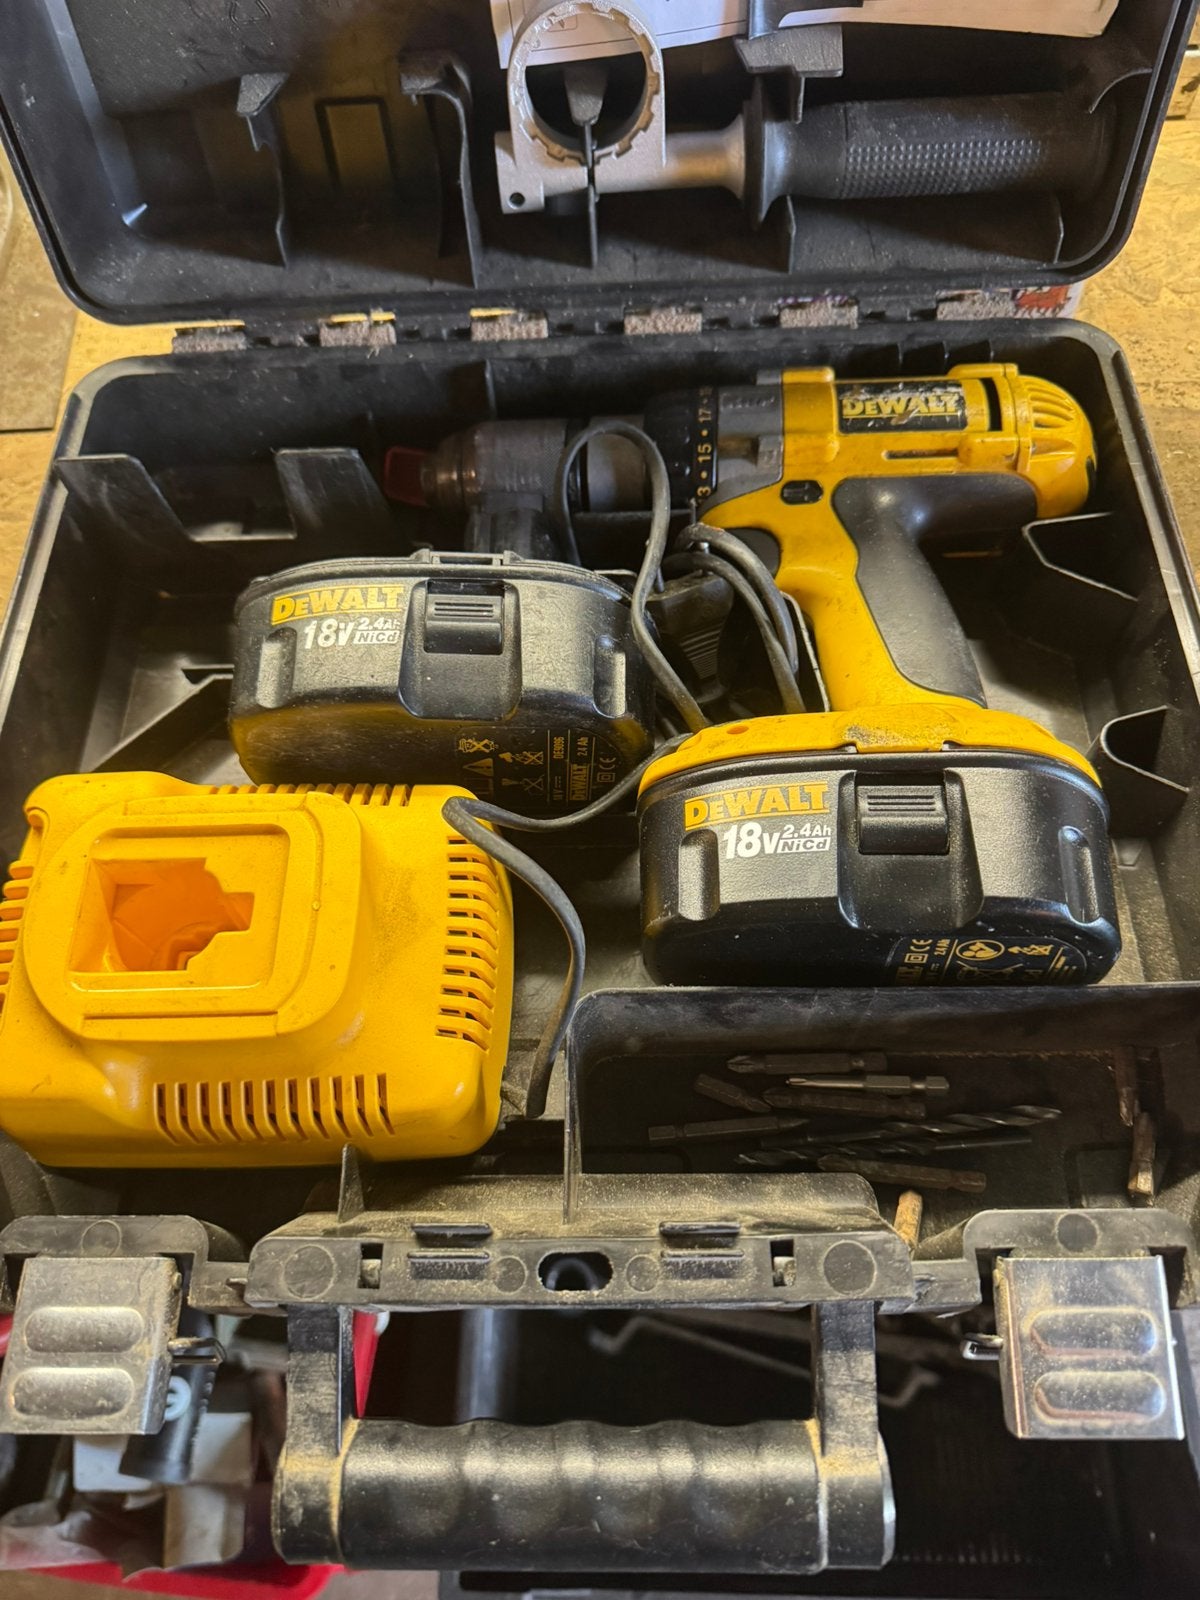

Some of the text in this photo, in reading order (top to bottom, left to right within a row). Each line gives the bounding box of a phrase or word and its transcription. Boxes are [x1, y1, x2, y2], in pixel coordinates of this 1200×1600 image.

[842, 394, 960, 416] DEWALT
[698, 408, 711, 422] 17
[698, 444, 712, 463] 15
[271, 587, 404, 622] DEWALT
[357, 631, 399, 644] NiCd
[571, 764, 588, 800] DEWALT
[684, 783, 829, 828] DEWALT
[781, 823, 831, 839] 2.4Ah
[781, 838, 829, 851] NiCd
